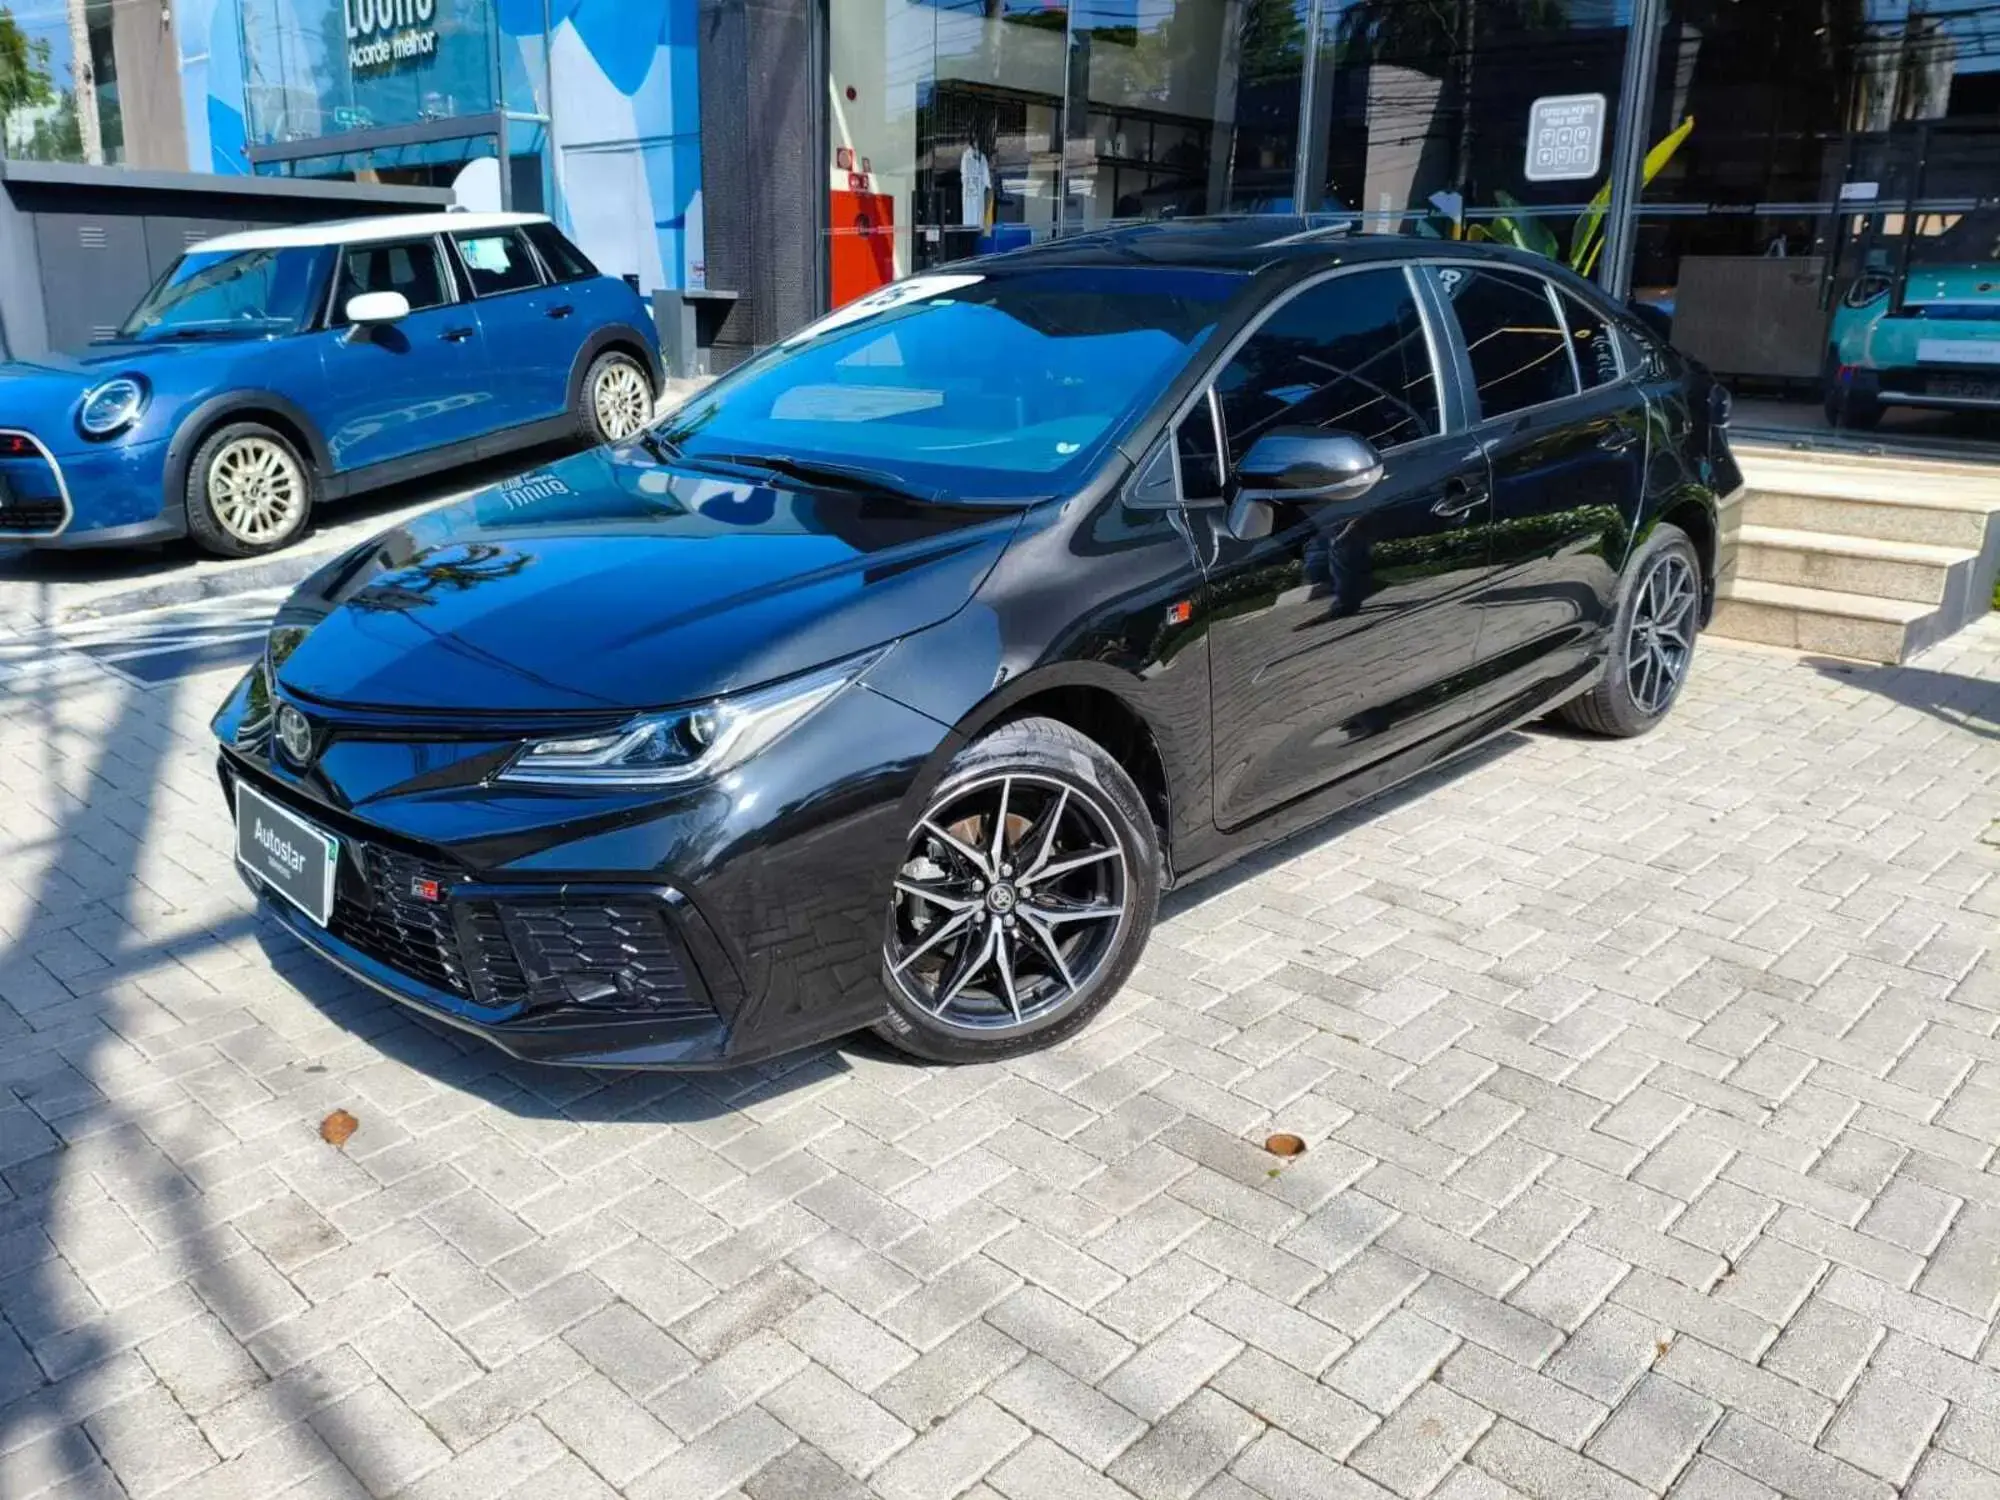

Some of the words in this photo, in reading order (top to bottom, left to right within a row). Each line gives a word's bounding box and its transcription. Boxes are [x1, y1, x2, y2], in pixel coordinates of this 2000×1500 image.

[349, 39, 390, 68] Acorde
[392, 28, 436, 60] melhor
[254, 817, 306, 873] Autostar
